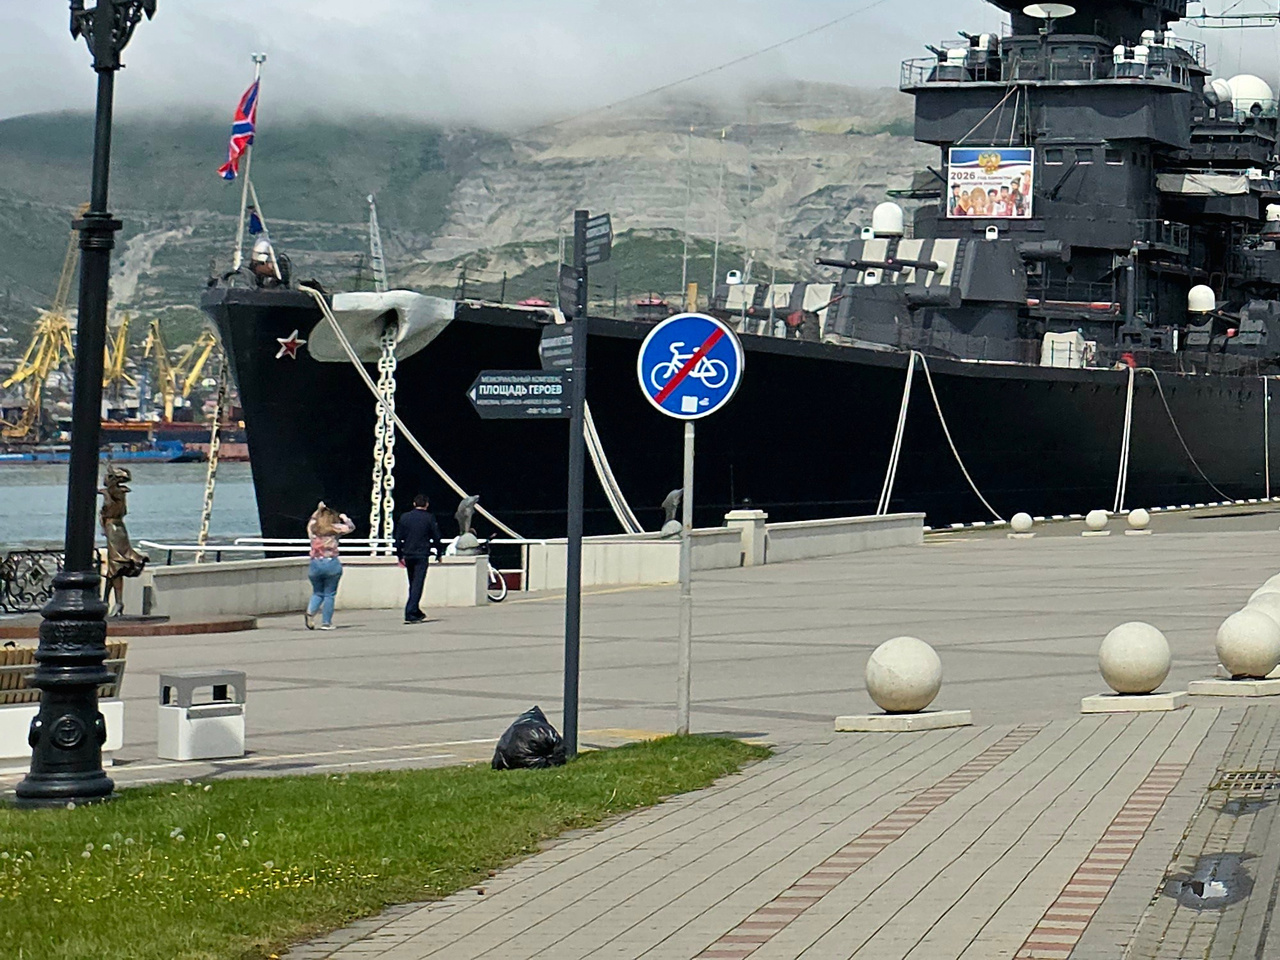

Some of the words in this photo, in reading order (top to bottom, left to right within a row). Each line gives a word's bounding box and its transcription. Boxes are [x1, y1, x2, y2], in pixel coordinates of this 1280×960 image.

[951, 172, 975, 180] 2026
[479, 385, 527, 396] ПЛОЩАДЬ
[529, 385, 562, 395] ГЕРОЕВ
